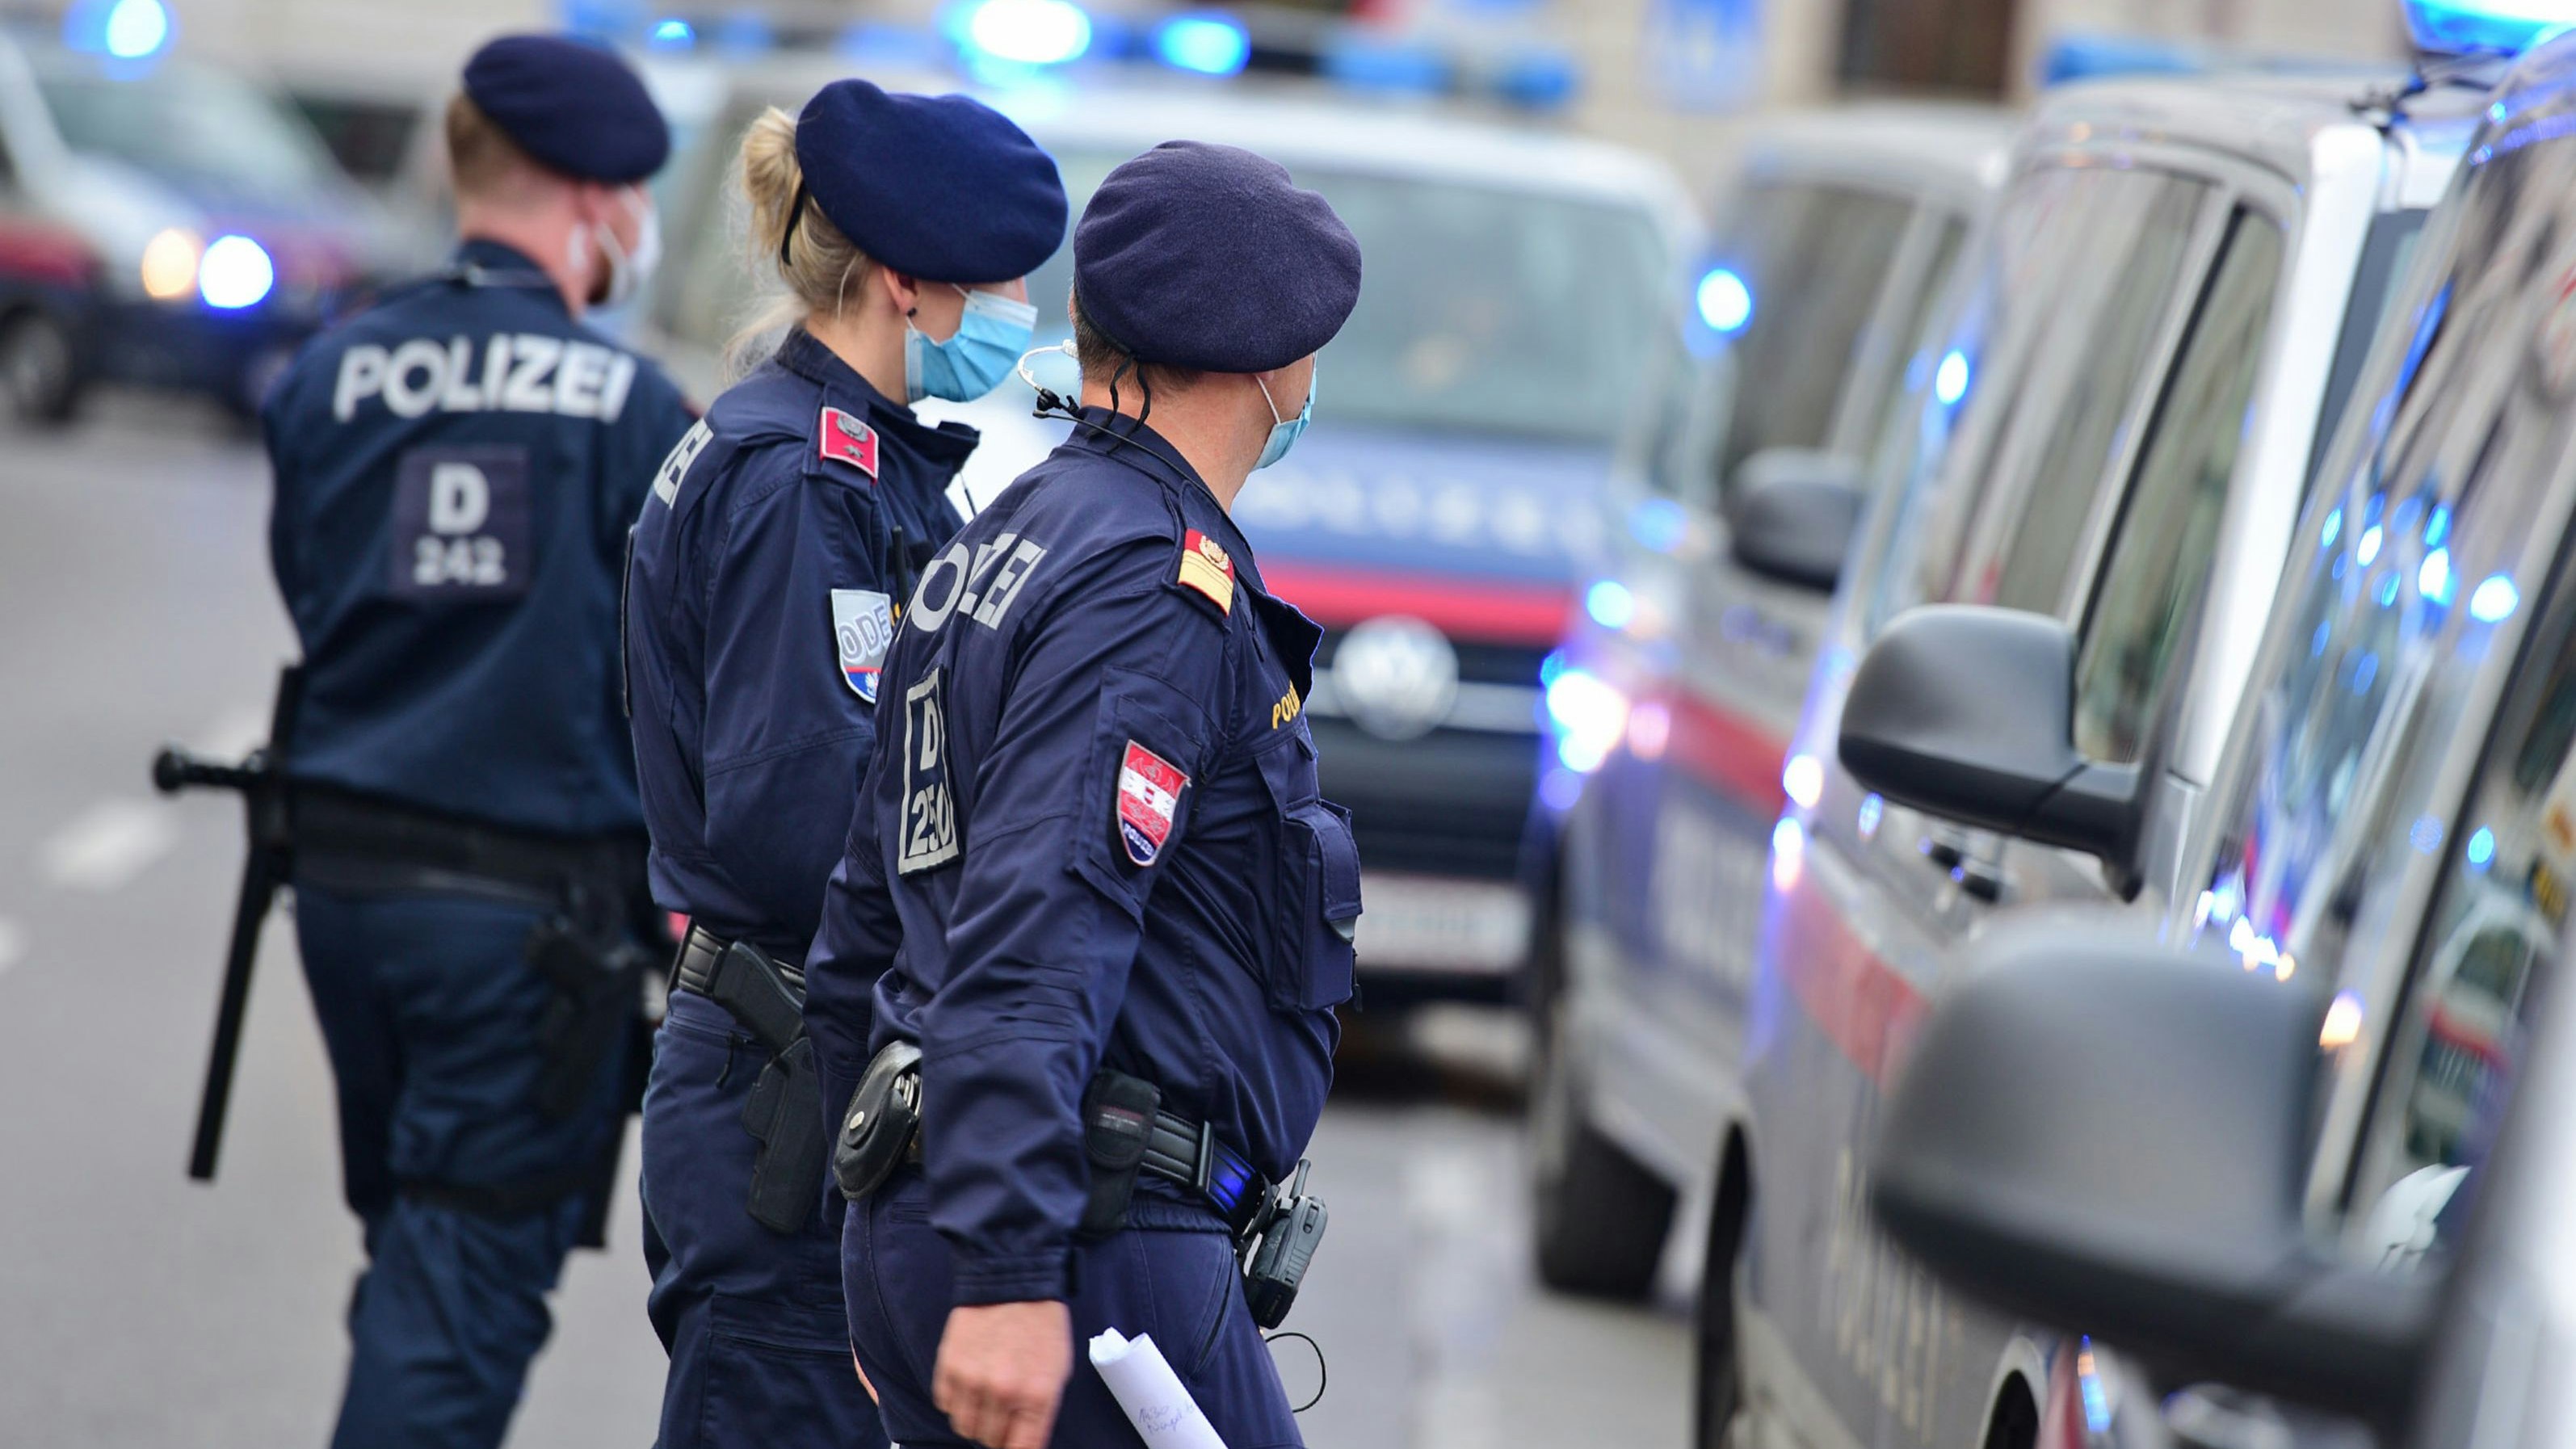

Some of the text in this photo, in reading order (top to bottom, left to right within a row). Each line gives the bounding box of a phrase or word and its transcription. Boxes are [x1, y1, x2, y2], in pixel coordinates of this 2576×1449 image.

[333, 332, 637, 424] POLIZEI
[428, 461, 491, 536] D
[413, 534, 508, 587] 242
[839, 601, 893, 664] ODE
[920, 697, 939, 771] D
[908, 781, 951, 857] 250
